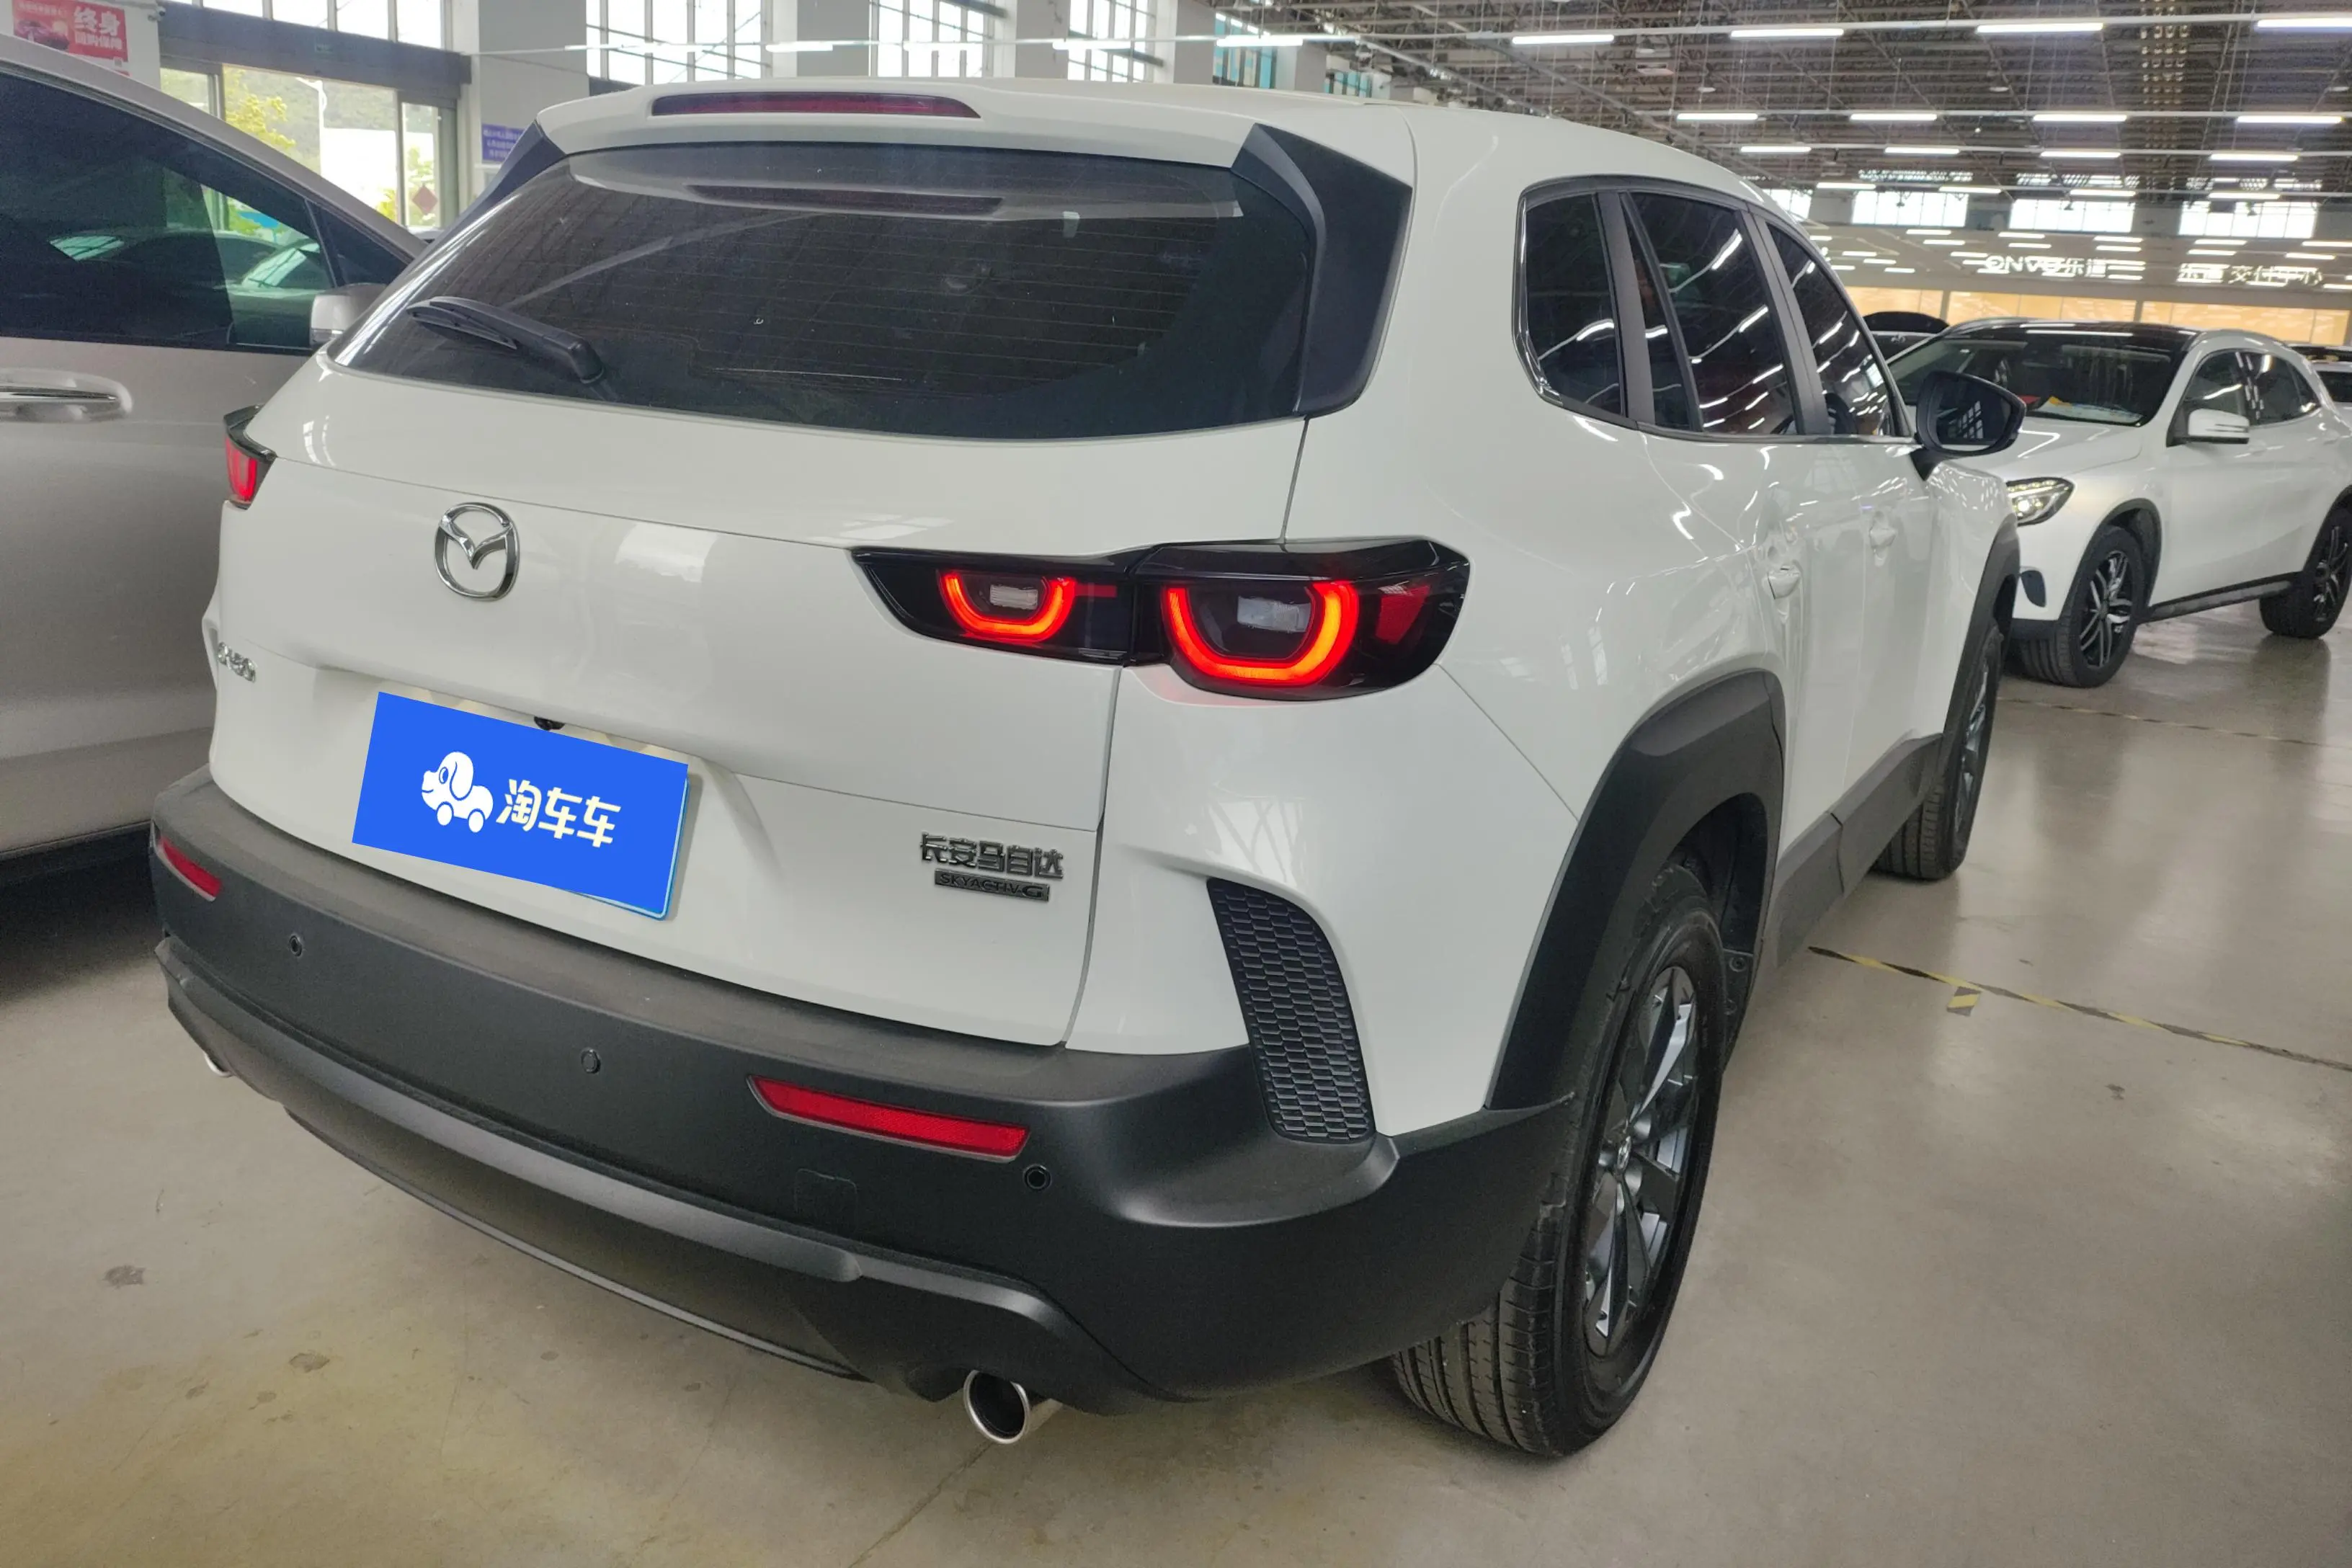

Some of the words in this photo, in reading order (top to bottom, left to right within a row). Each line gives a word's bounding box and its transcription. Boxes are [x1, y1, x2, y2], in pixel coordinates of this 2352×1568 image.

[920, 832, 1064, 880] 长安马自达
